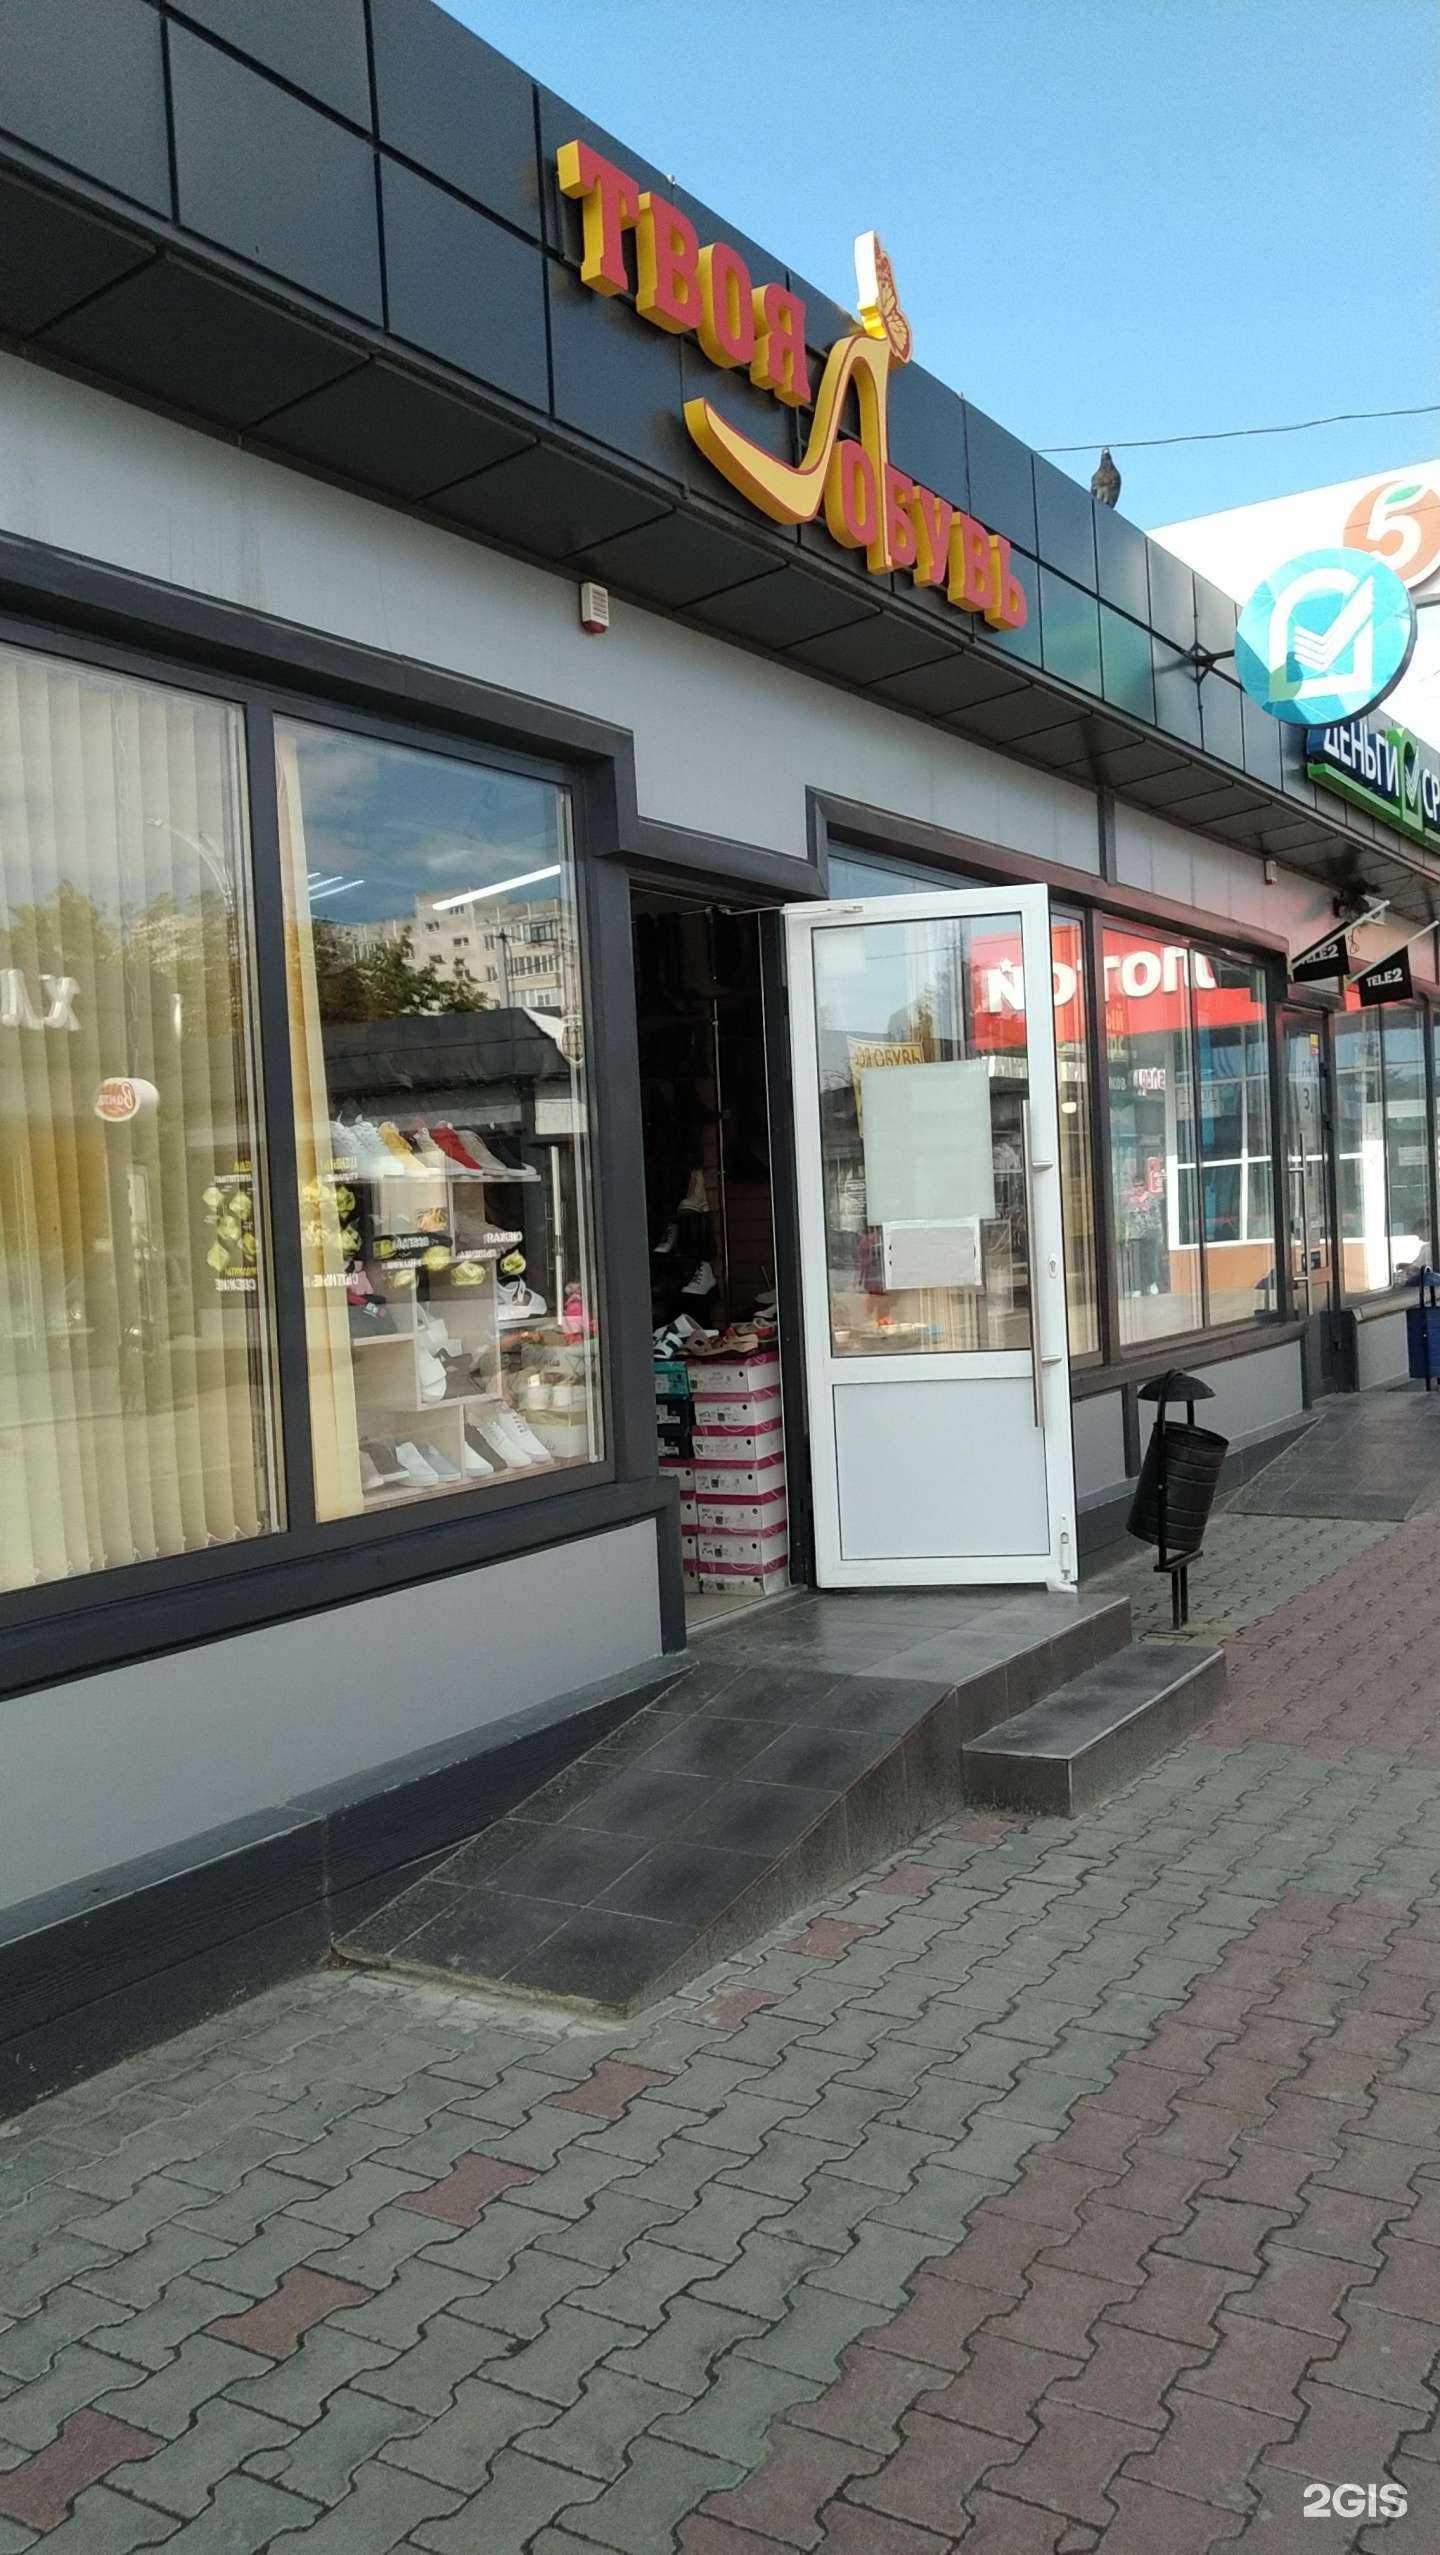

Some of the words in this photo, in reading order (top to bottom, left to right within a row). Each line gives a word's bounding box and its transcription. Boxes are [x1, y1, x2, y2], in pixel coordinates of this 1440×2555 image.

[556, 139, 811, 408] ТВОЯ
[824, 440, 1028, 630] ОБУВЬ
[1366, 967, 1404, 988] TELE2
